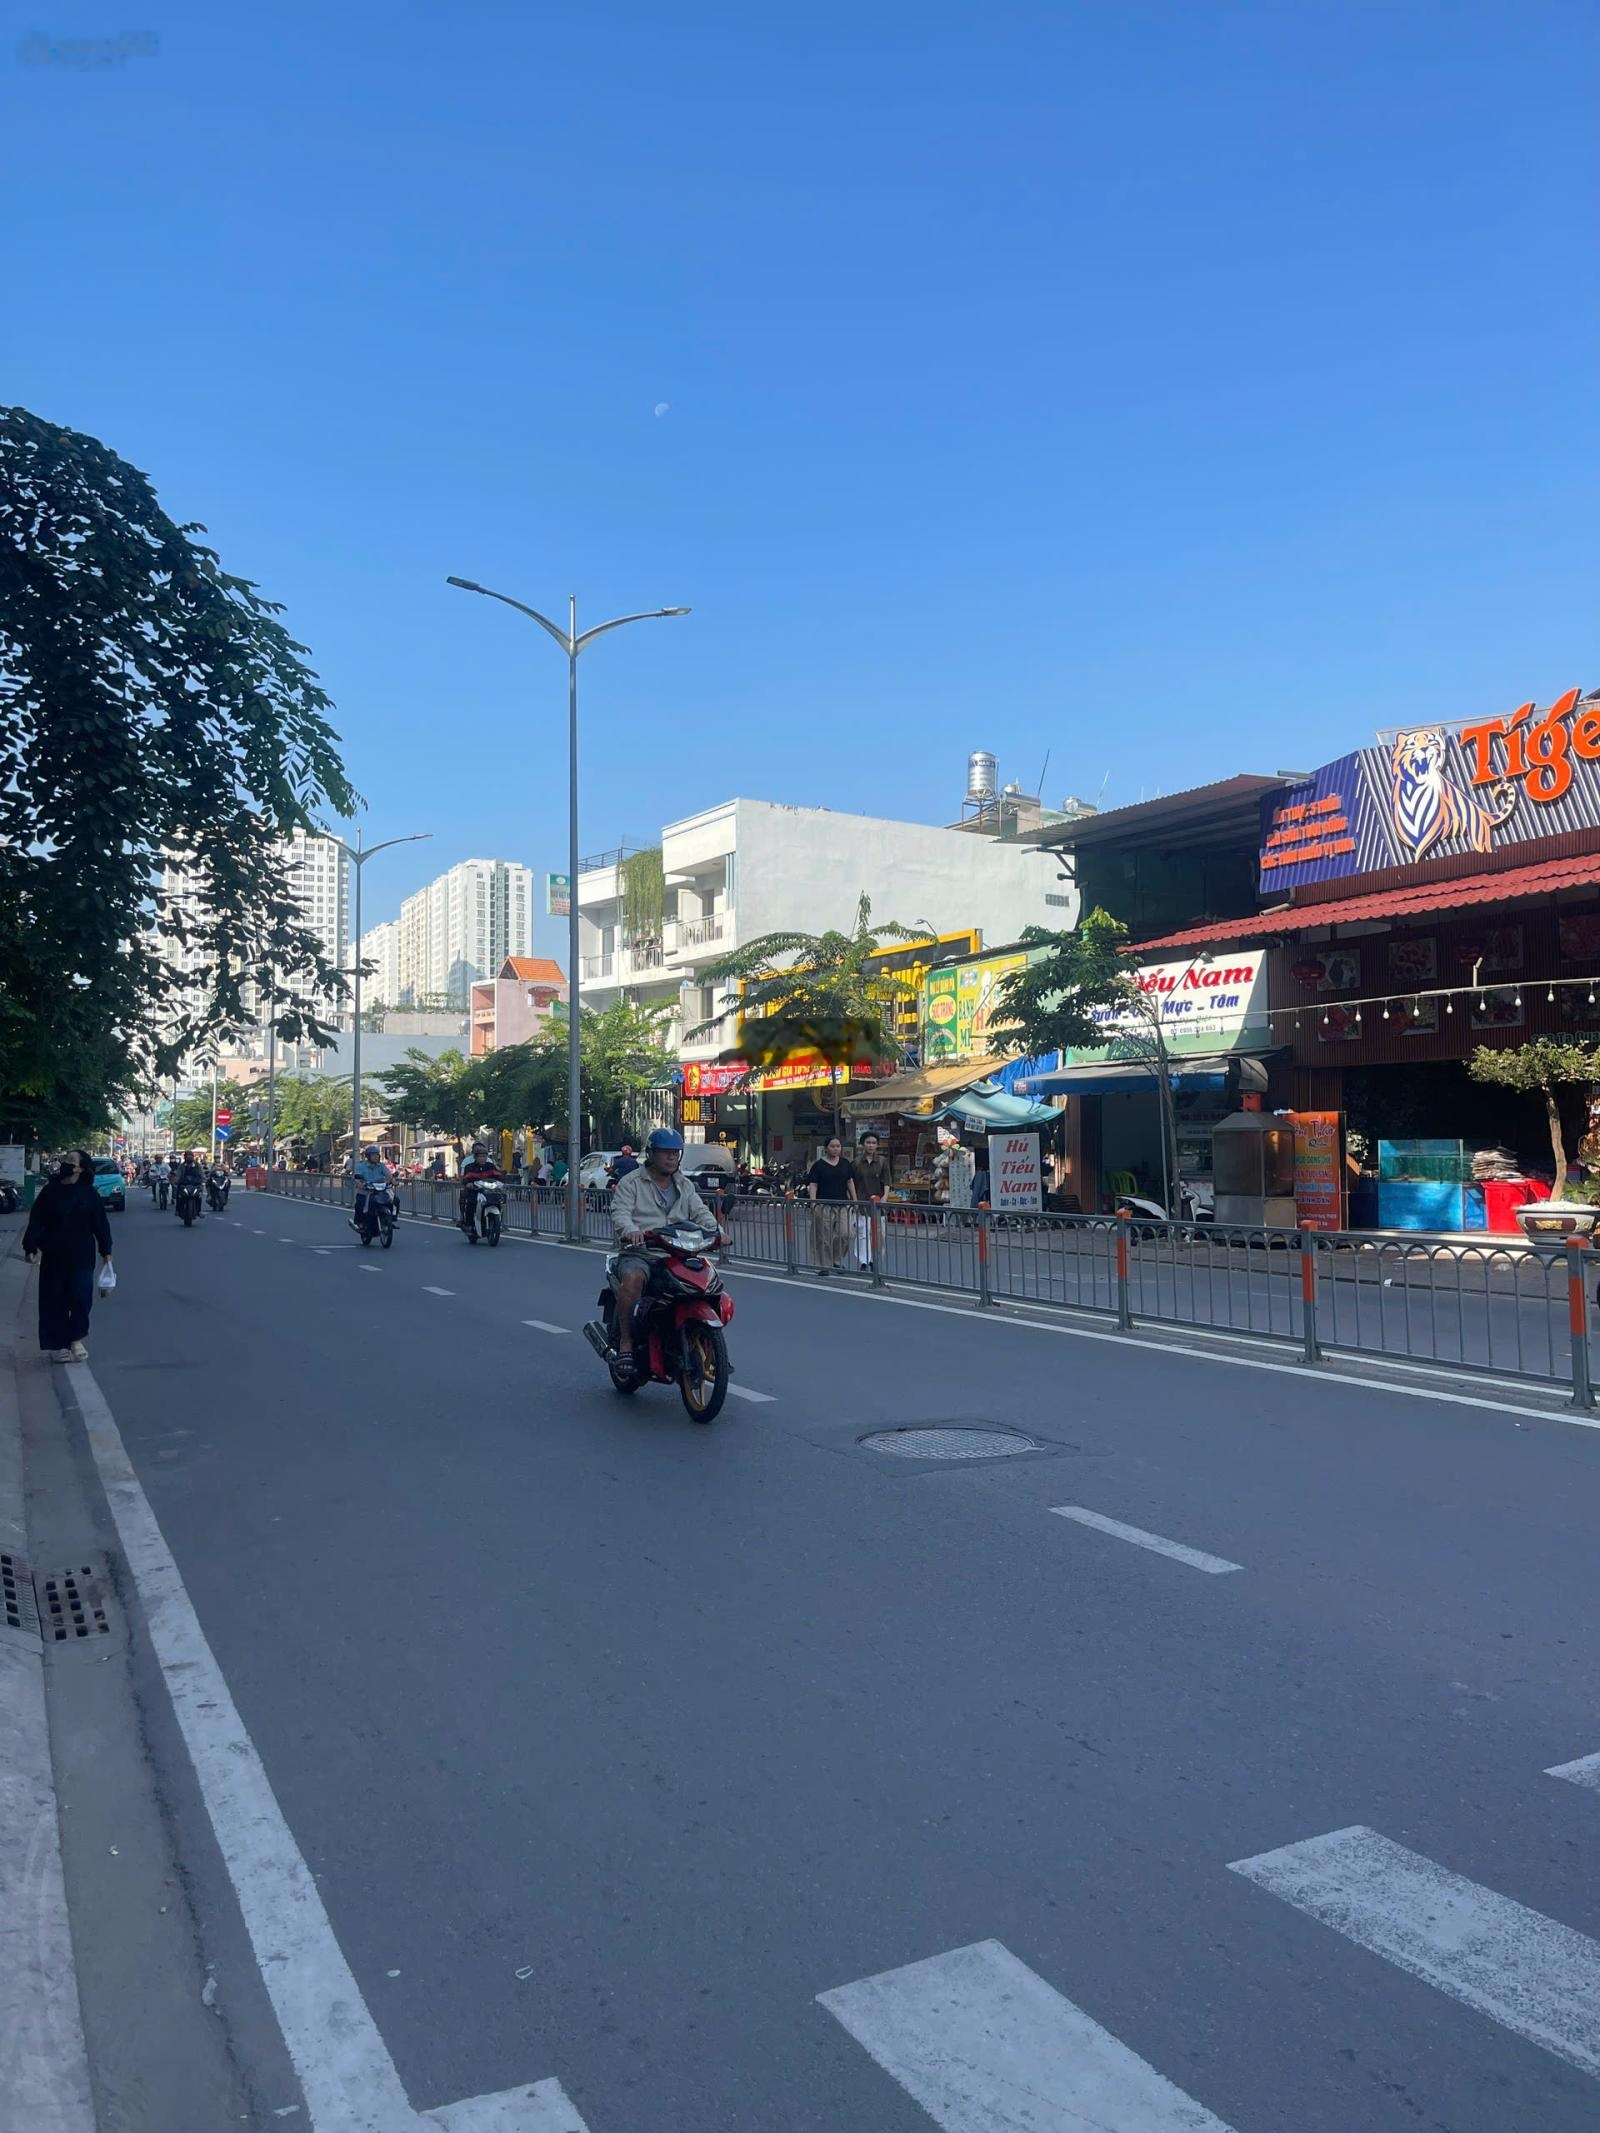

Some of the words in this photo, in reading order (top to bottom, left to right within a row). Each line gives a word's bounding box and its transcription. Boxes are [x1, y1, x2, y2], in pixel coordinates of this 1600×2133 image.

[1182, 965, 1254, 991] Nam
[1209, 993, 1240, 1010] Tôm
[1001, 1156, 1035, 1174] Tiếu
[1000, 1180, 1037, 1194] Nam
